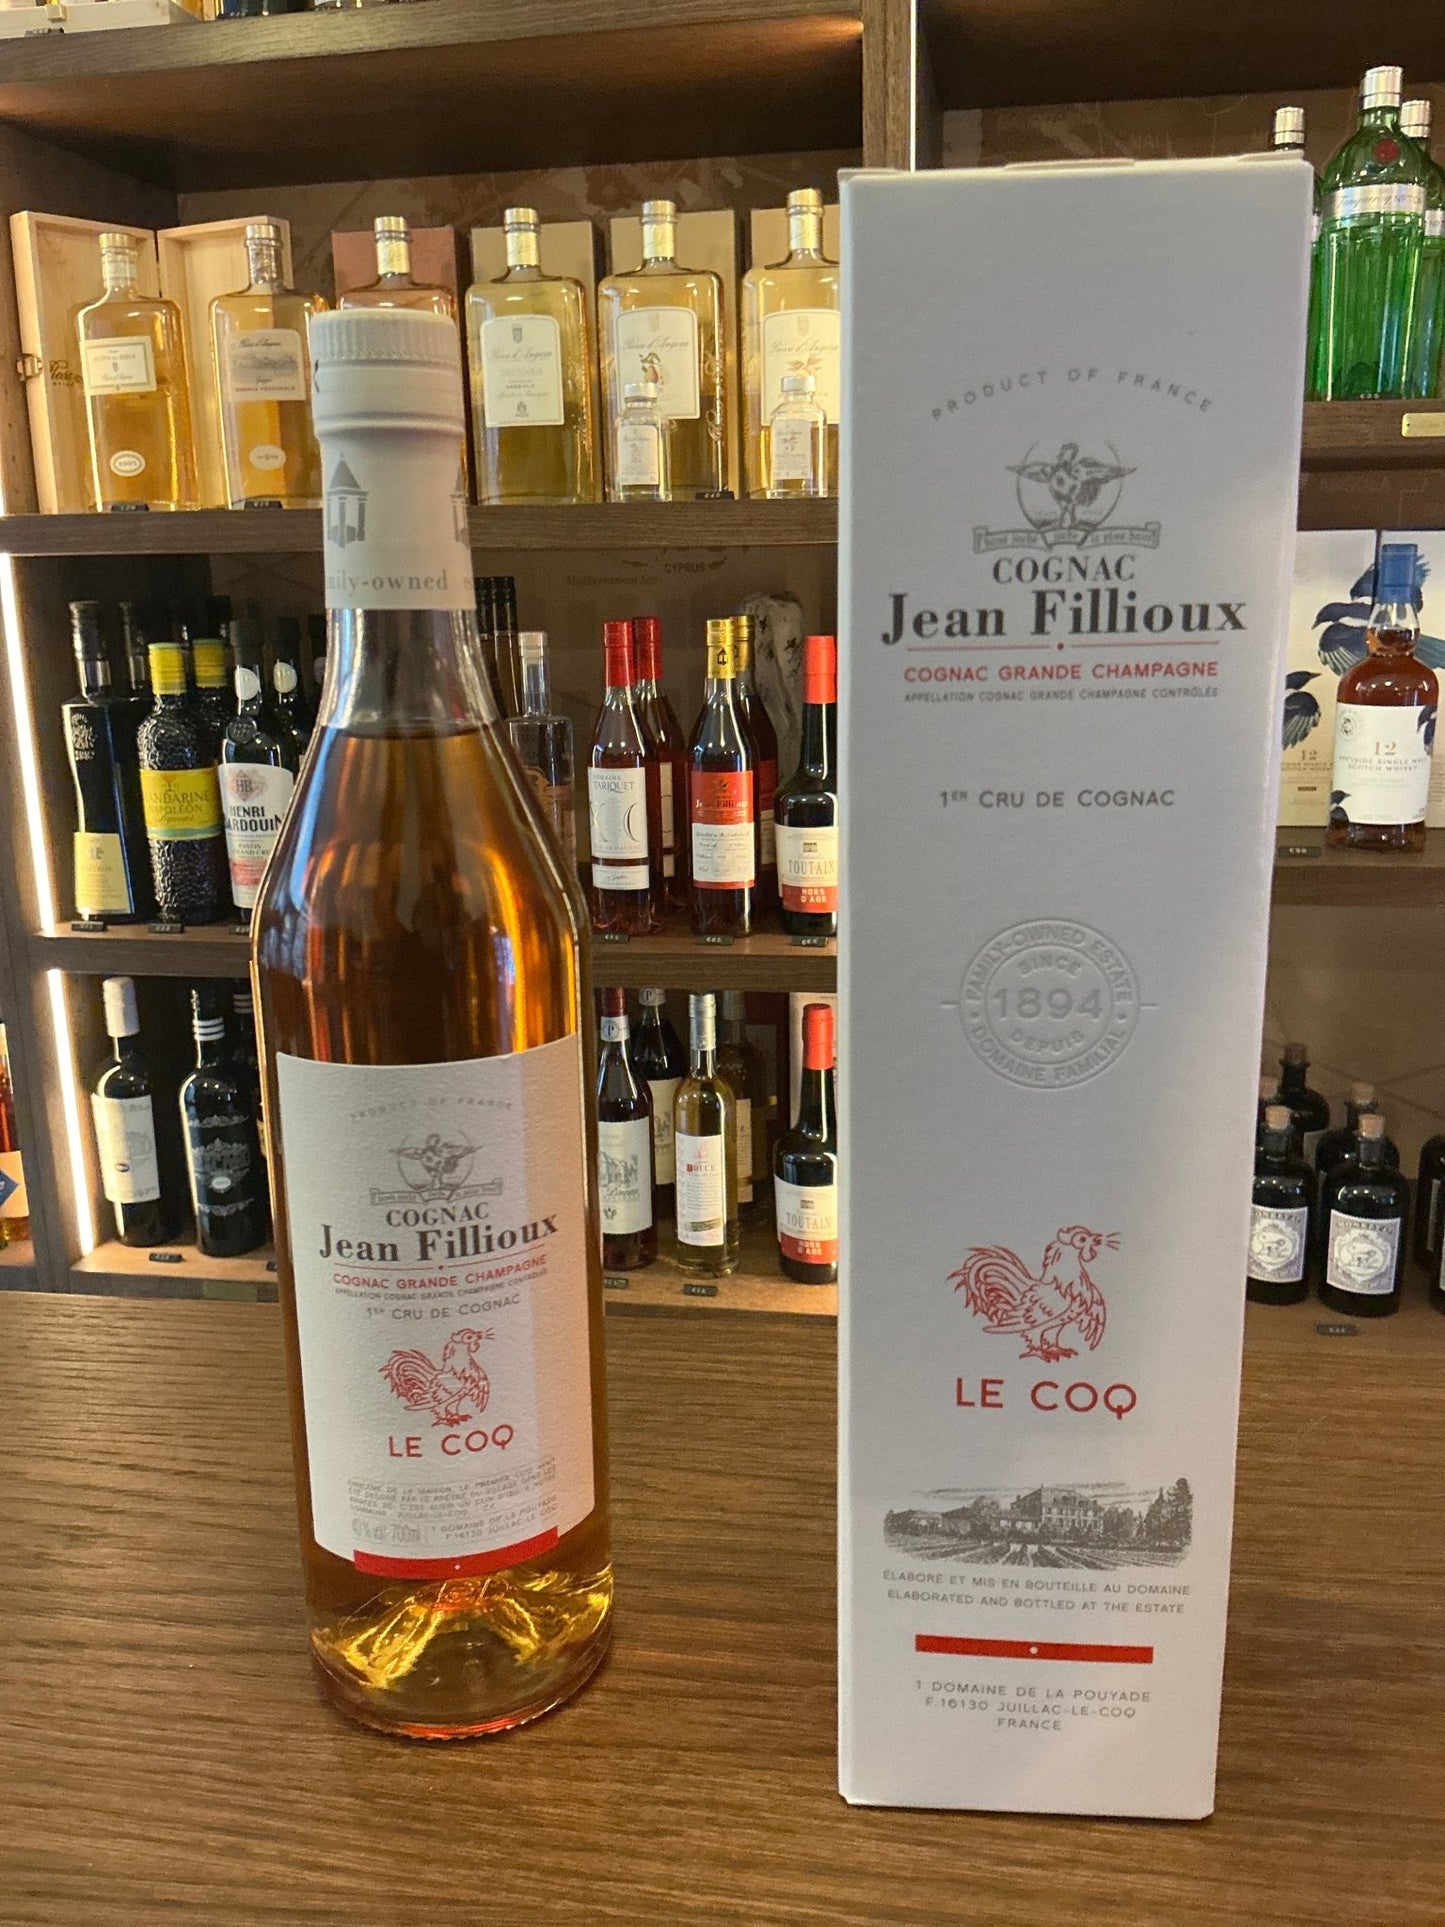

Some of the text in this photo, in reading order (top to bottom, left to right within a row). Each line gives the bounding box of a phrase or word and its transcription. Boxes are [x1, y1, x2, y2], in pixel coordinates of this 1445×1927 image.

[931, 368, 1213, 421] PRODUCT OF FRANCE
[992, 553, 1137, 584] COGNAC
[881, 587, 1247, 645] Jean Fillioux
[903, 660, 1219, 683] COGNAC GRANDE CHAMPAGNE
[903, 690, 975, 703] APPELLATION
[978, 690, 1024, 702] COGNAC
[1029, 688, 1076, 701] GRANDE
[1078, 687, 1147, 700] CHAMPAGNE
[1373, 739, 1397, 756] 12
[593, 780, 635, 793] TARIQUET
[978, 789, 1025, 808] CRU
[1035, 790, 1065, 808] DE
[1076, 788, 1176, 808] COGNAC
[229, 805, 266, 818] HENRI
[1017, 953, 1084, 978] SINCE
[990, 987, 1103, 1020] 1894
[1009, 1028, 1085, 1053] DEPUIS
[386, 1201, 489, 1228] COGNAC
[320, 1214, 559, 1262] Jean Fillioux
[332, 1254, 548, 1290] COGNAC GRANDE CHAMPAGNE
[391, 1307, 423, 1321] CRU
[430, 1306, 450, 1319] DE
[458, 1293, 522, 1317] COGNAC
[955, 1376, 1138, 1421] LE COQ
[388, 1423, 515, 1458] LE COQ
[949, 1573, 966, 1586] ET
[971, 1574, 996, 1588] MIS
[1001, 1576, 1020, 1589] EN
[1024, 1578, 1098, 1594] BOUTEILLE
[1103, 1582, 1122, 1594] AU
[1126, 1584, 1191, 1595] DOMAINE
[887, 1588, 1186, 1614] ELABORATED AND BOTTLED AT THE ESTATE
[915, 1680, 1151, 1703] 1 DOMAINE DE LA POUYADE
[924, 1697, 1137, 1719] F.16130 JUILLAC-LE-COQ
[997, 1719, 1063, 1731] FRANCE
